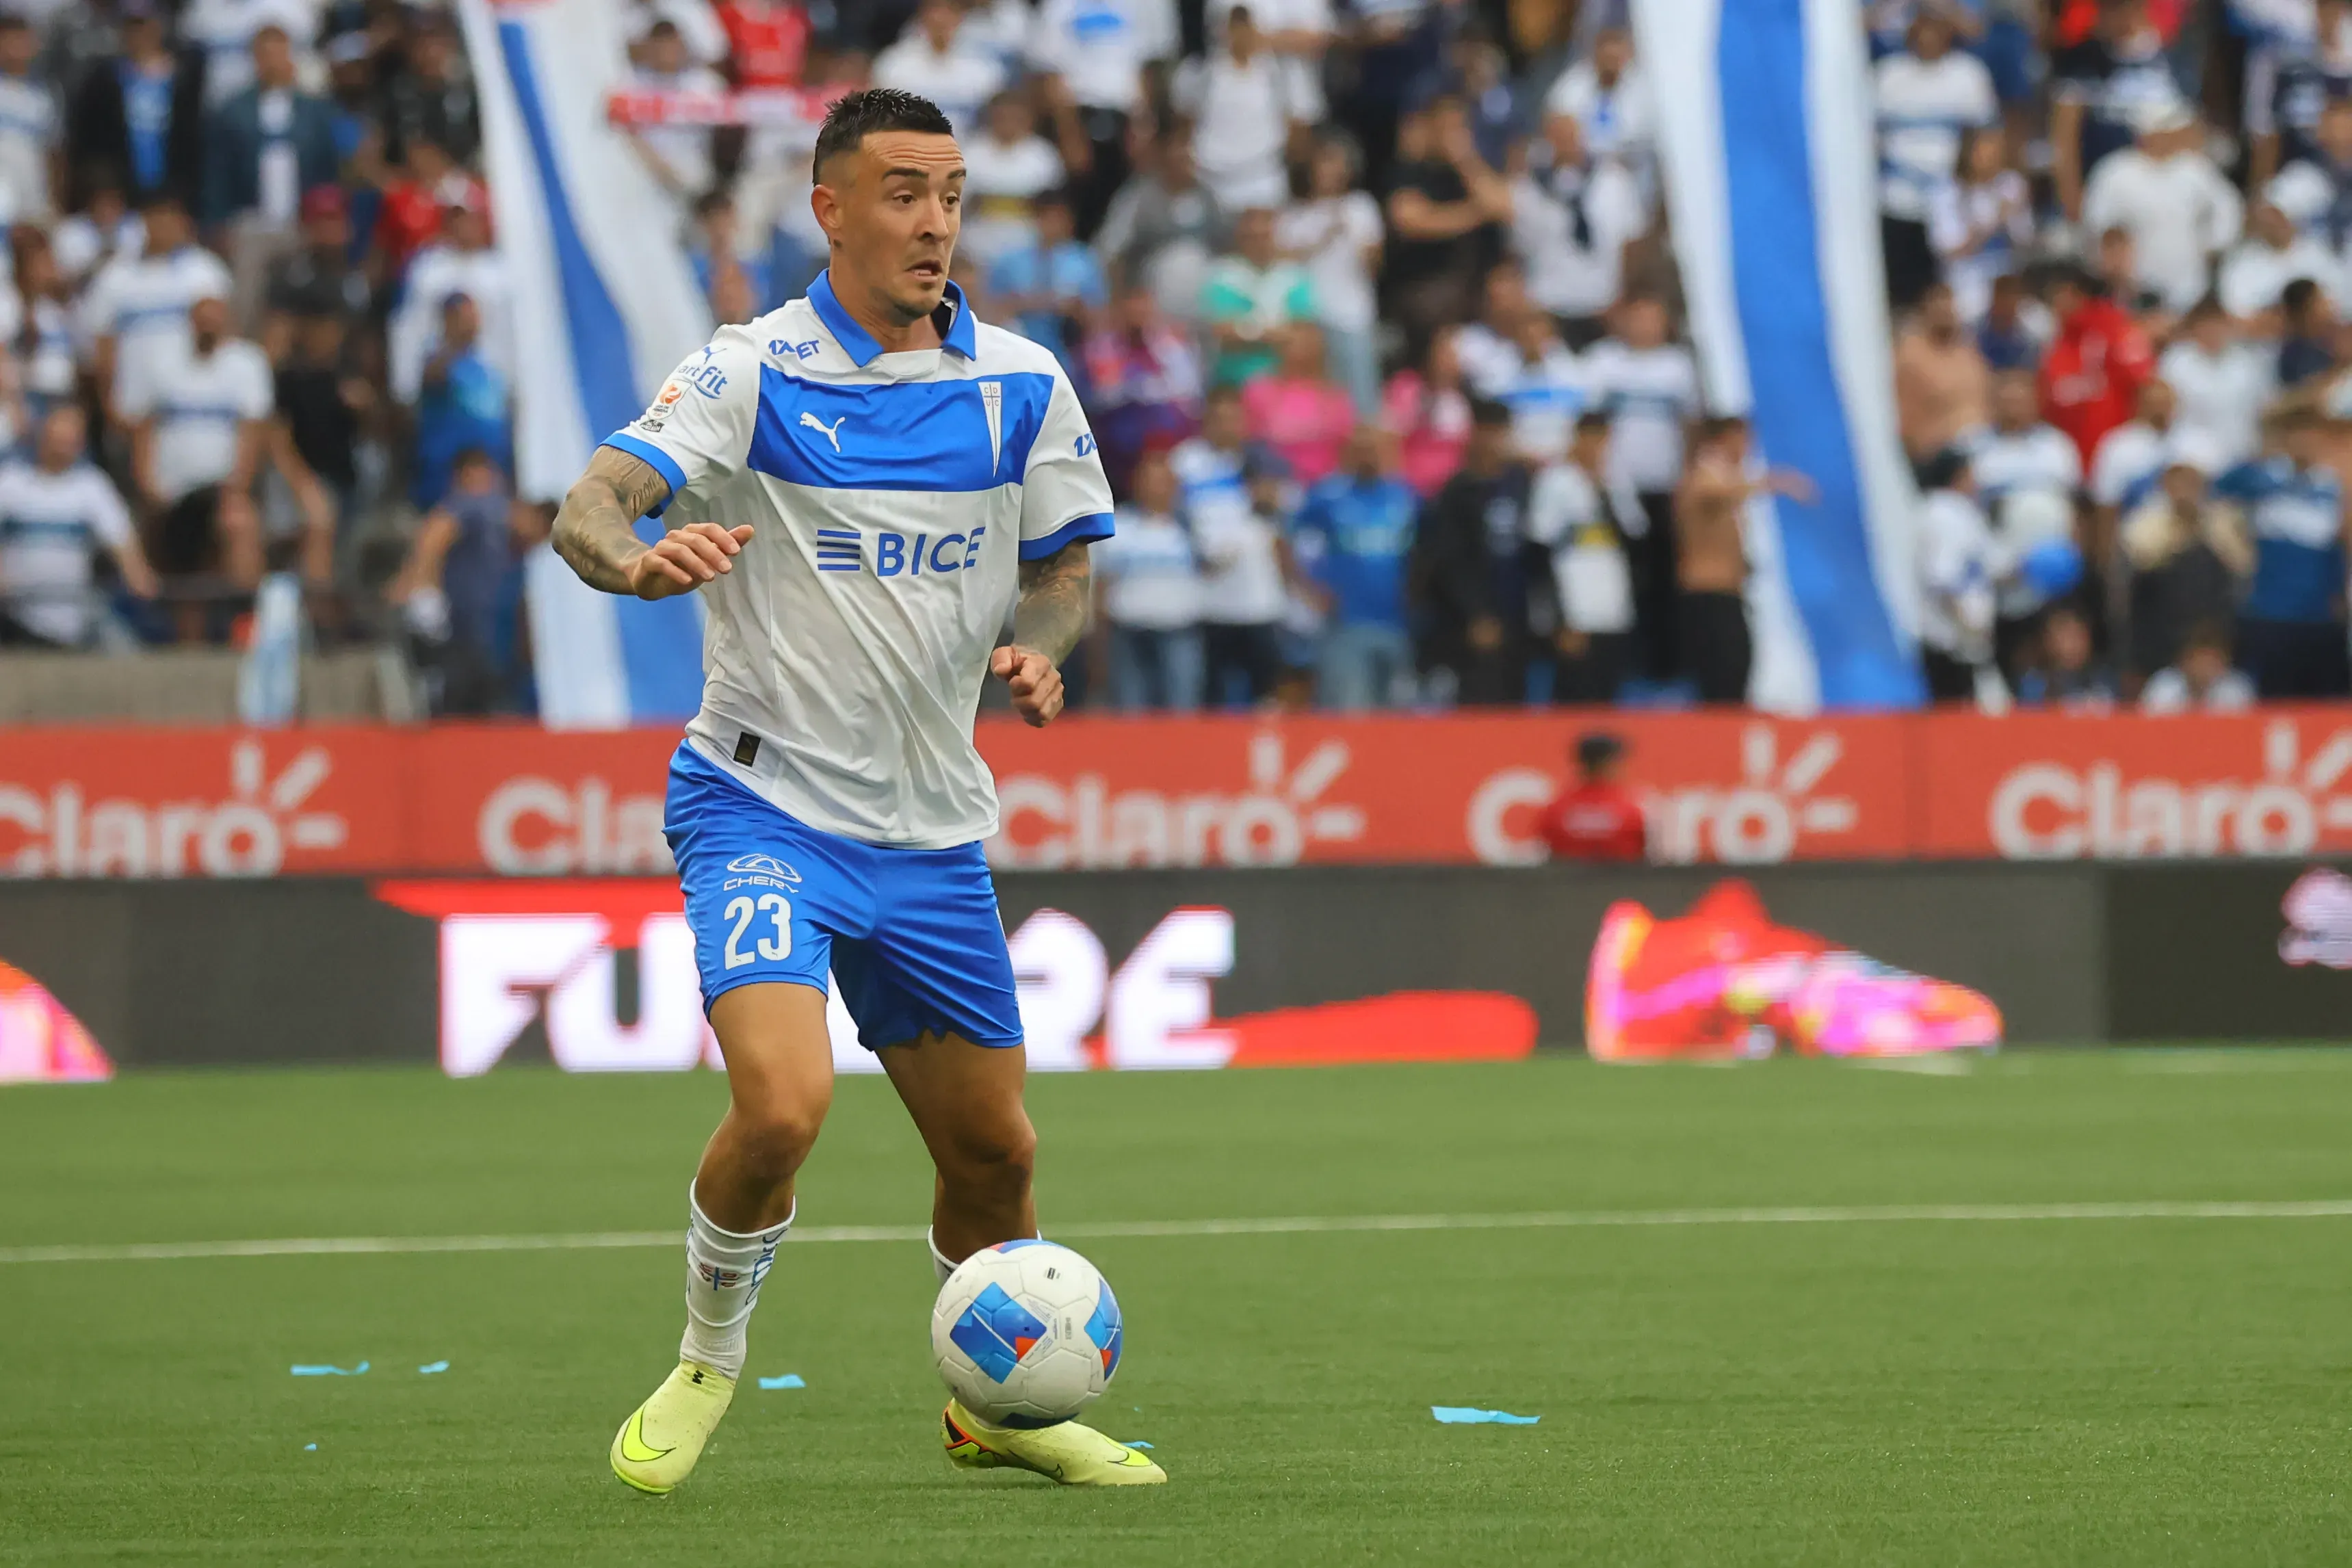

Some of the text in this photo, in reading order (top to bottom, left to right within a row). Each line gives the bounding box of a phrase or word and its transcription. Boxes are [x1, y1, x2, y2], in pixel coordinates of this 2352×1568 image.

[697, 366, 727, 395] fit
[877, 526, 985, 576] BICE
[477, 775, 677, 876] Cla
[987, 773, 1303, 871] Claro
[1466, 768, 1795, 866] Cro
[1989, 761, 2318, 860] Claro
[723, 876, 799, 893] CHERY
[724, 893, 792, 970] 23
[440, 906, 1236, 1077] FURE
